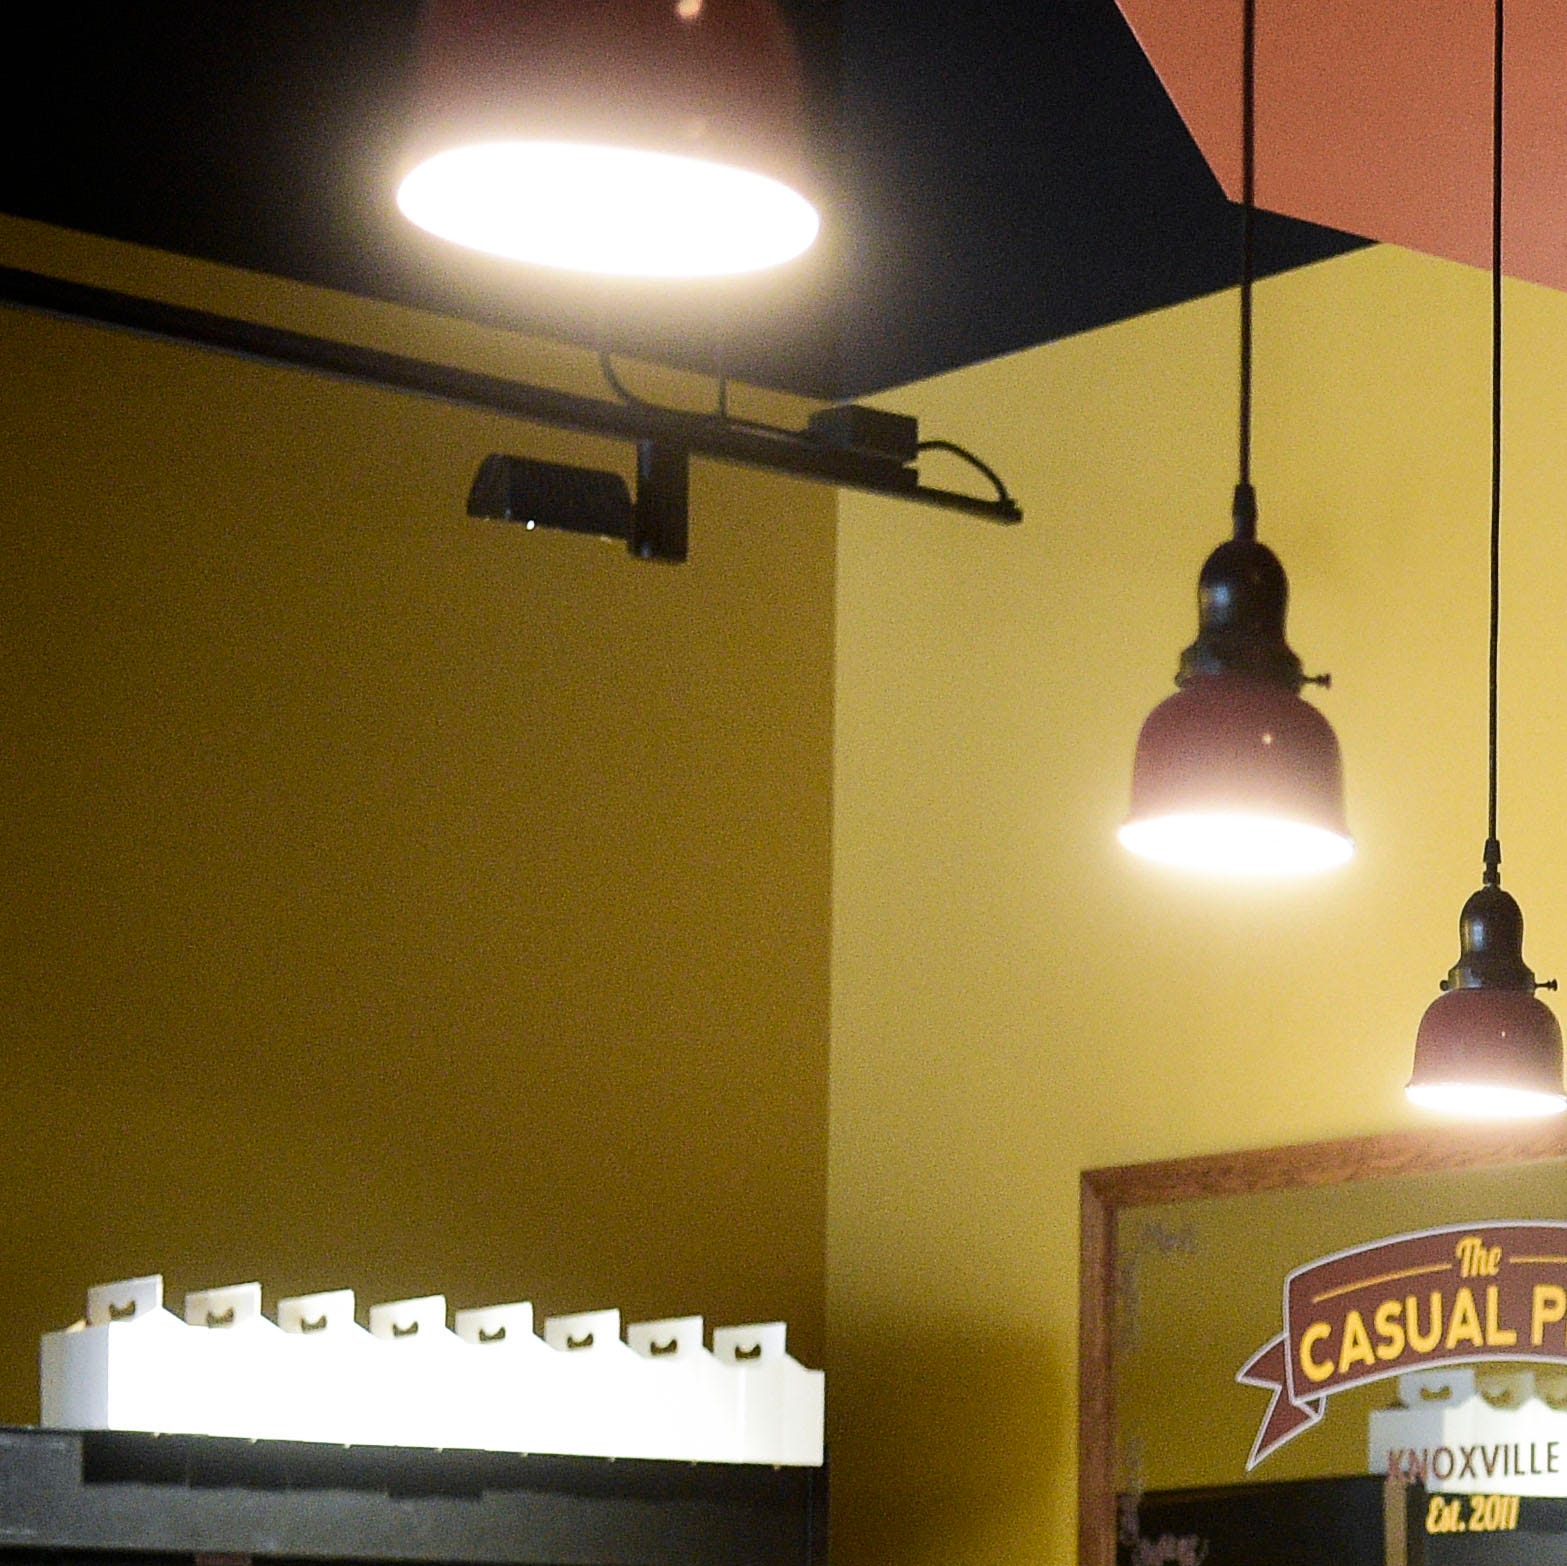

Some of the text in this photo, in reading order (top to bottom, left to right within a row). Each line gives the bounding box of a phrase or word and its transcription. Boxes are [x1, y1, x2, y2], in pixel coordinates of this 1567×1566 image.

[1455, 1235, 1502, 1279] The
[1300, 1284, 1517, 1383] CASUAL
[1386, 1441, 1560, 1484] KNOXVILLE
[1425, 1495, 1520, 1534] Est. 2011
